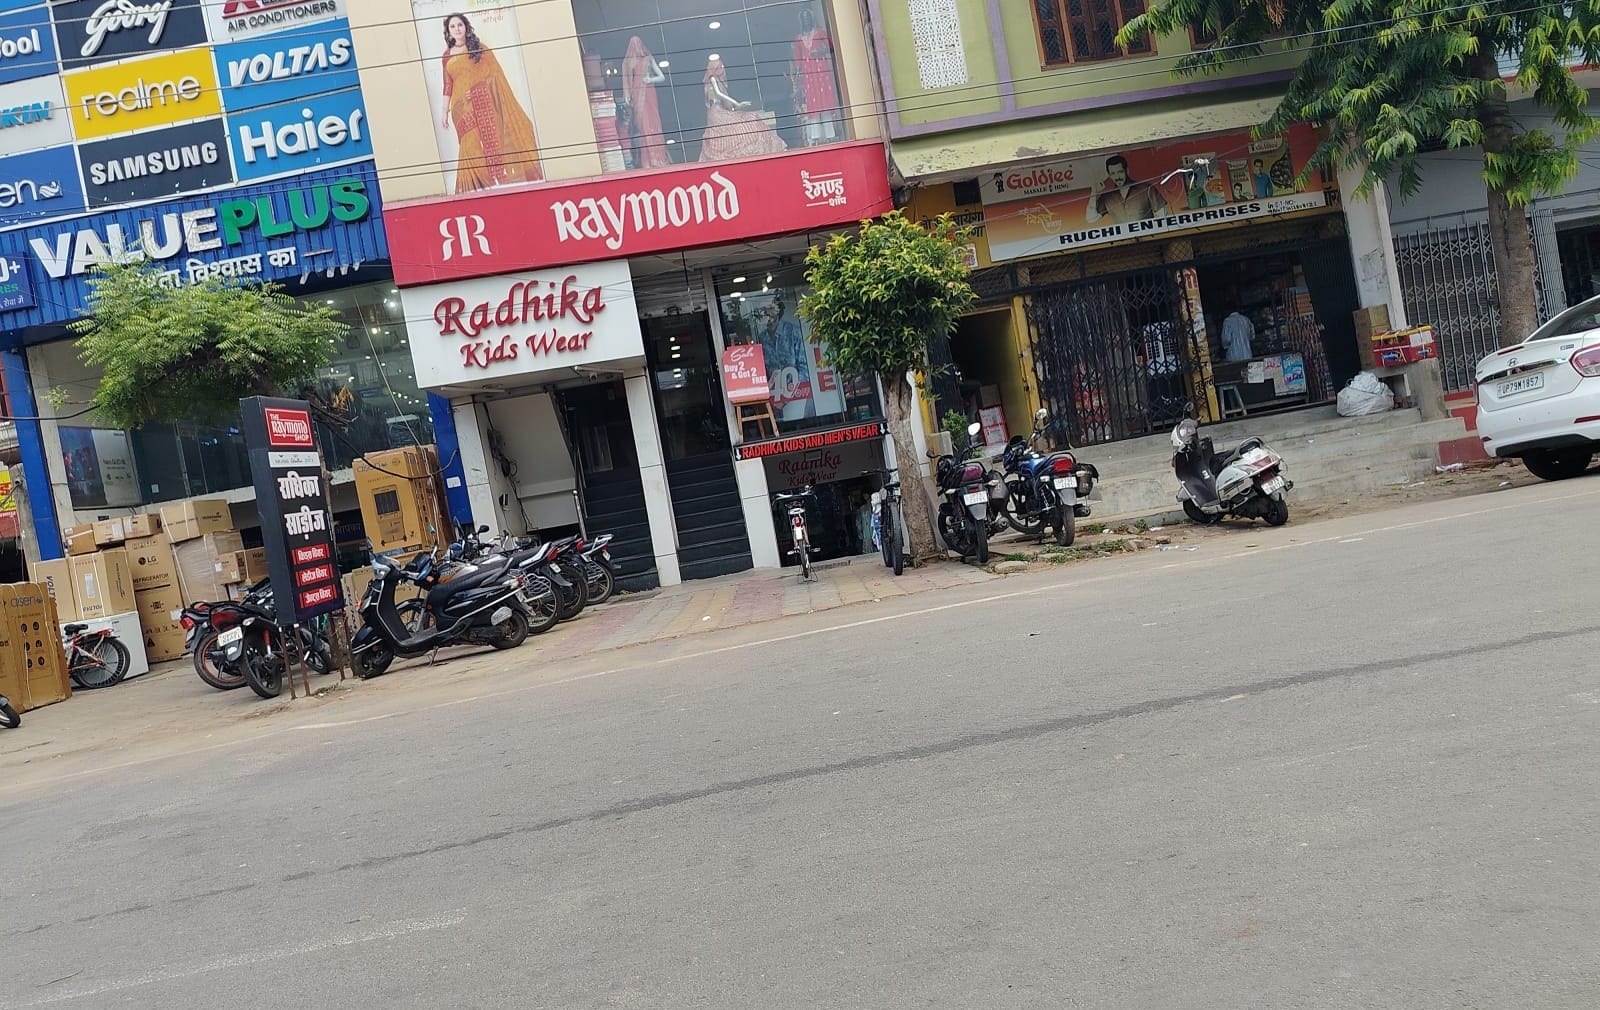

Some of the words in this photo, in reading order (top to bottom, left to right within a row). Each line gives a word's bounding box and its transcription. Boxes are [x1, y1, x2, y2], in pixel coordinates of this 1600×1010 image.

[228, 20, 247, 32] AIR
[249, 1, 336, 28] CONDITIONERS
[0, 28, 41, 61] ool
[228, 38, 350, 87] VOLTAS
[81, 76, 200, 120] realme
[239, 108, 363, 163] Haier
[90, 142, 218, 185] SAMSUNG
[1006, 164, 1074, 190] Goldiee
[550, 171, 740, 250] Raymond
[1060, 225, 1122, 246] RUCHI
[1128, 202, 1261, 234] ENTERPRISES
[267, 247, 296, 267] का
[433, 275, 605, 337] Radhika
[460, 335, 518, 370] Kids
[526, 327, 593, 358] Wear
[738, 361, 745, 371] 2
[751, 368, 758, 378] 2
[271, 420, 308, 438] Raymond
[742, 441, 782, 458] RADHIKA
[784, 438, 804, 451] KIDS
[806, 435, 824, 448] AND
[825, 430, 852, 445] MEN'S
[852, 424, 879, 439] WEAR
[277, 471, 320, 499] राधिका
